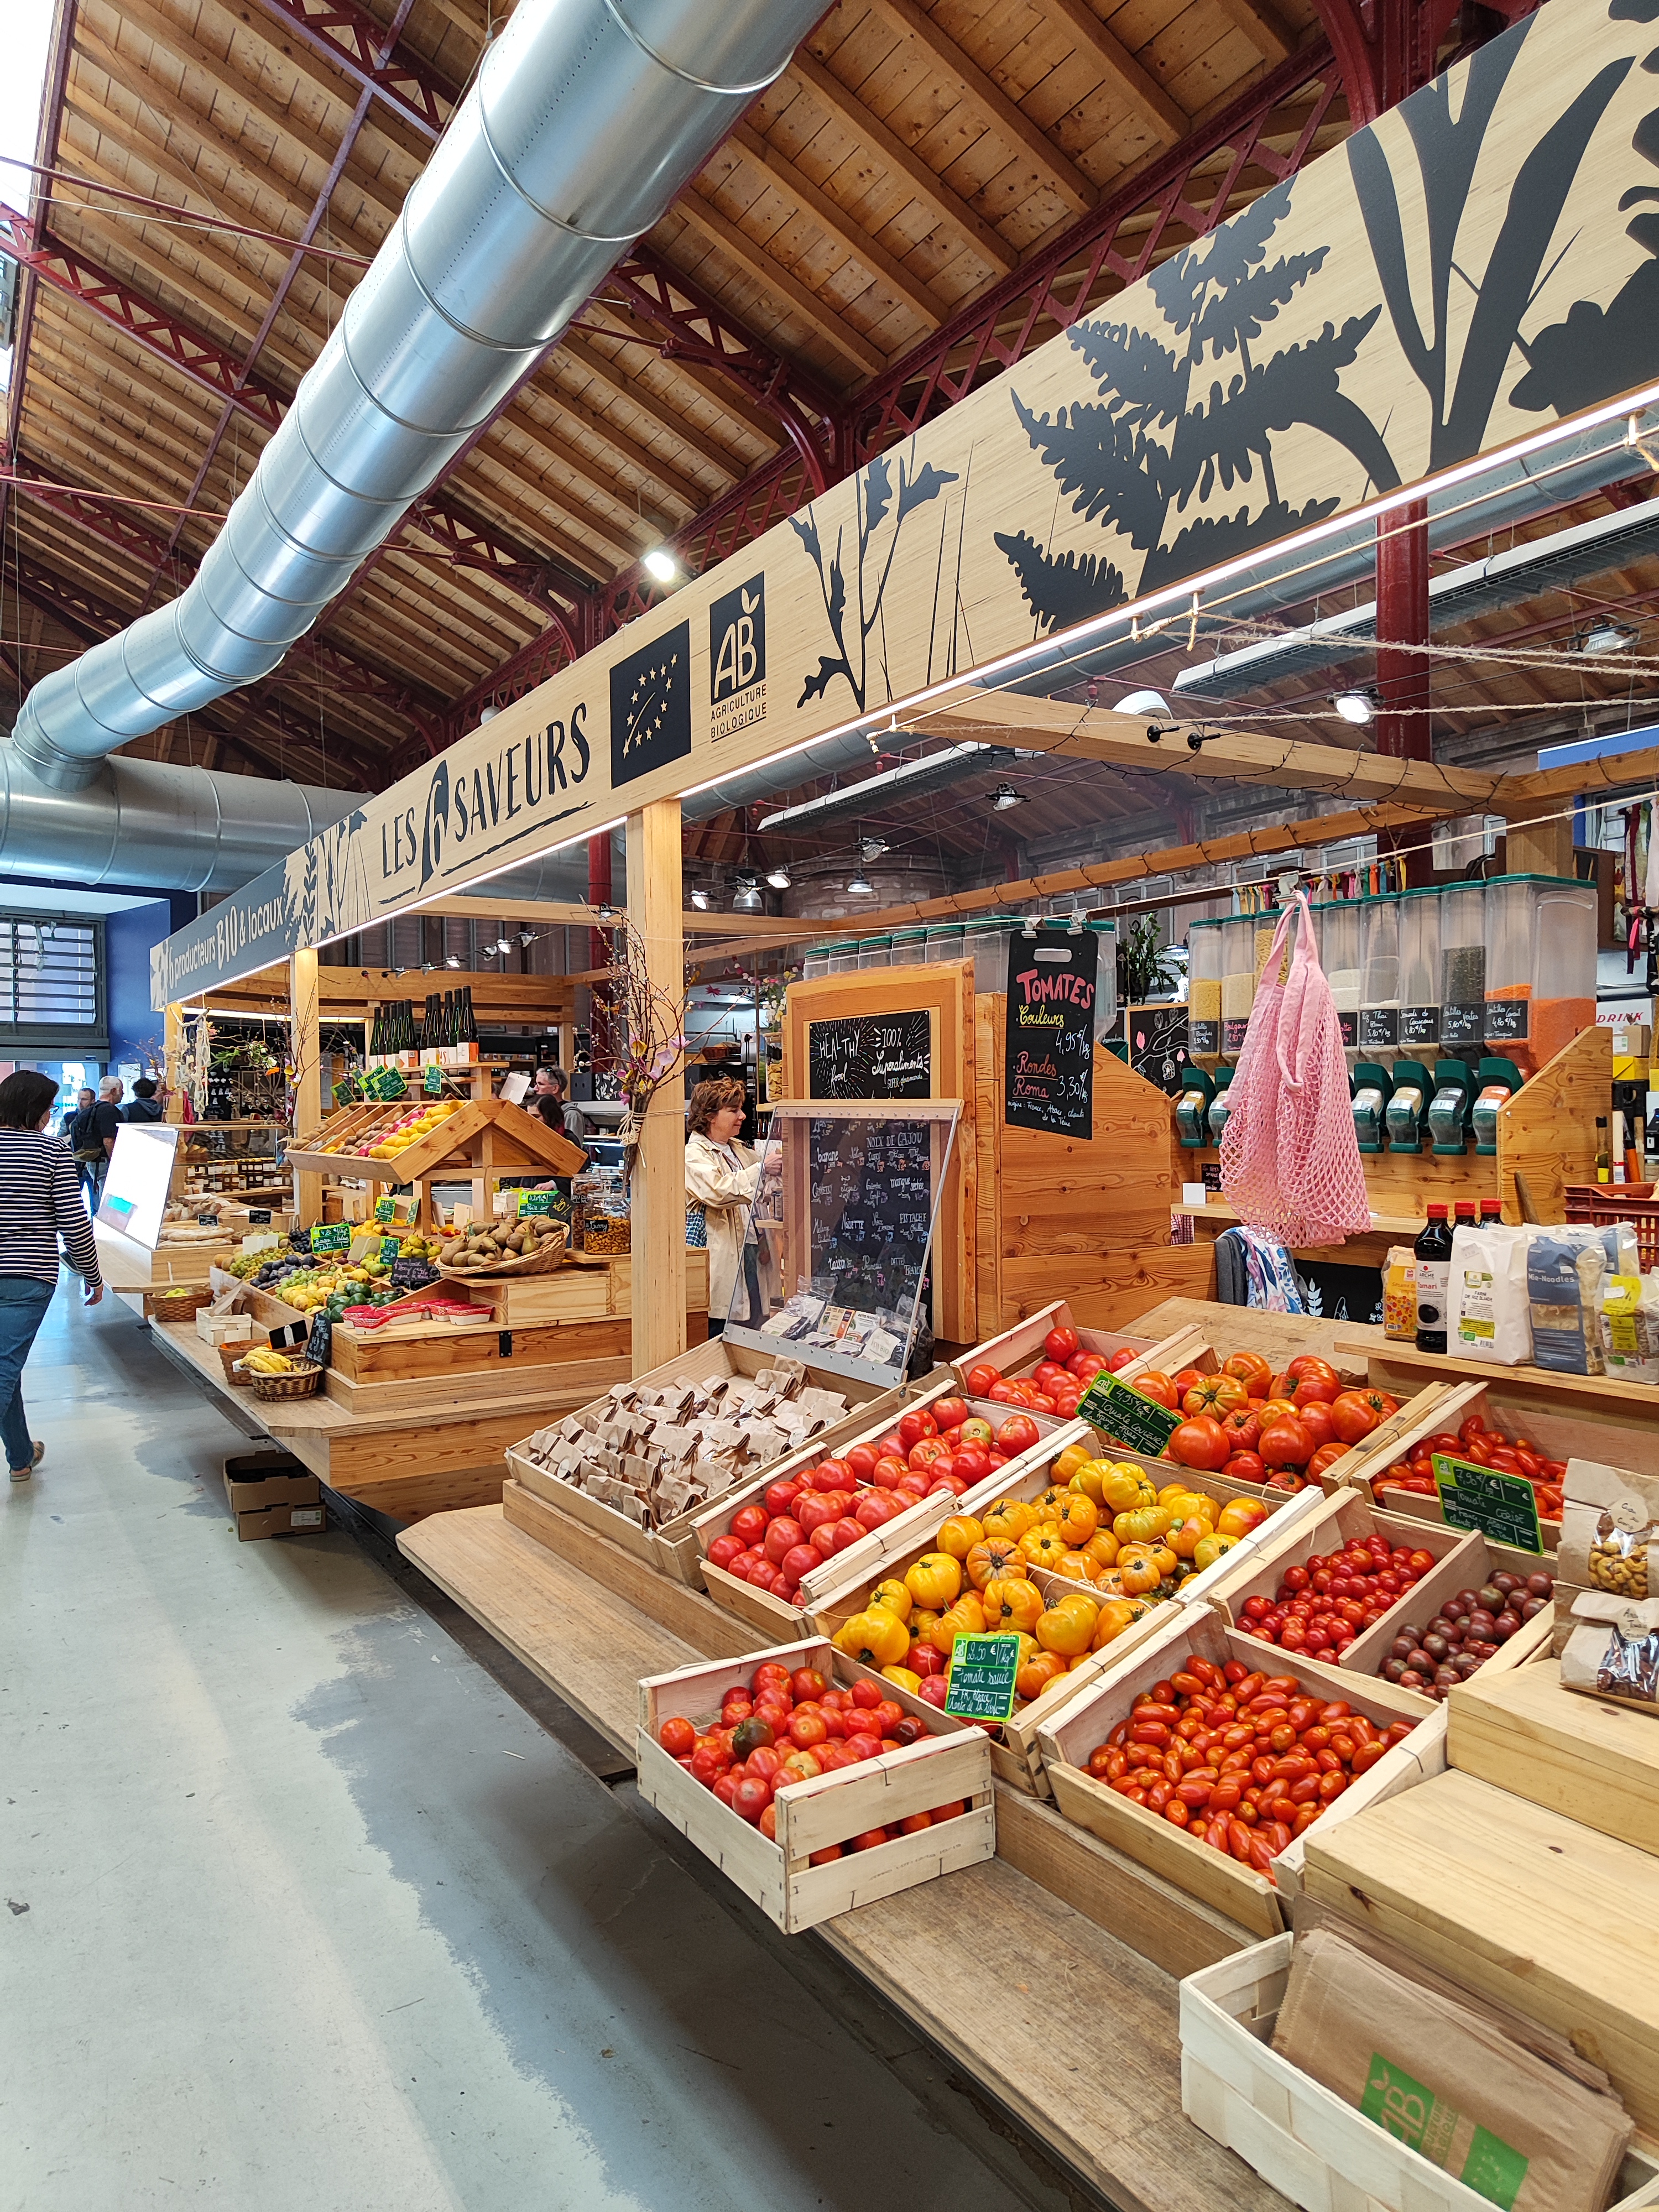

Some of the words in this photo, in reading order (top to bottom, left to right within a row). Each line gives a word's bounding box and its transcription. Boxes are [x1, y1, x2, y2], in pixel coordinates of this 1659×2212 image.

[714, 615, 757, 699] AB
[711, 684, 767, 722] AGRICULTURE
[711, 702, 767, 739] BIOLOGIQUE
[382, 806, 417, 879] LES
[454, 702, 590, 842] SAVEURS
[174, 933, 216, 984] producteurs
[216, 905, 238, 971] BIO
[239, 910, 246, 947] &
[248, 896, 283, 943] locaux
[1016, 968, 1094, 1009] TOMATES
[1019, 1004, 1065, 1028] Couleurs
[819, 1026, 860, 1061] HEALTHY
[881, 1027, 902, 1048] 100%
[830, 1062, 848, 1096] food
[1016, 1051, 1057, 1077] Rondes
[1013, 1076, 1050, 1099] Roma
[866, 1136, 884, 1147] NOIX
[886, 1135, 896, 1146] DE
[898, 1132, 922, 1146] CAJOU
[1528, 1273, 1575, 1282] Mie-Noodles
[1095, 1379, 1109, 1389] AB
[955, 1644, 964, 1656] AB
